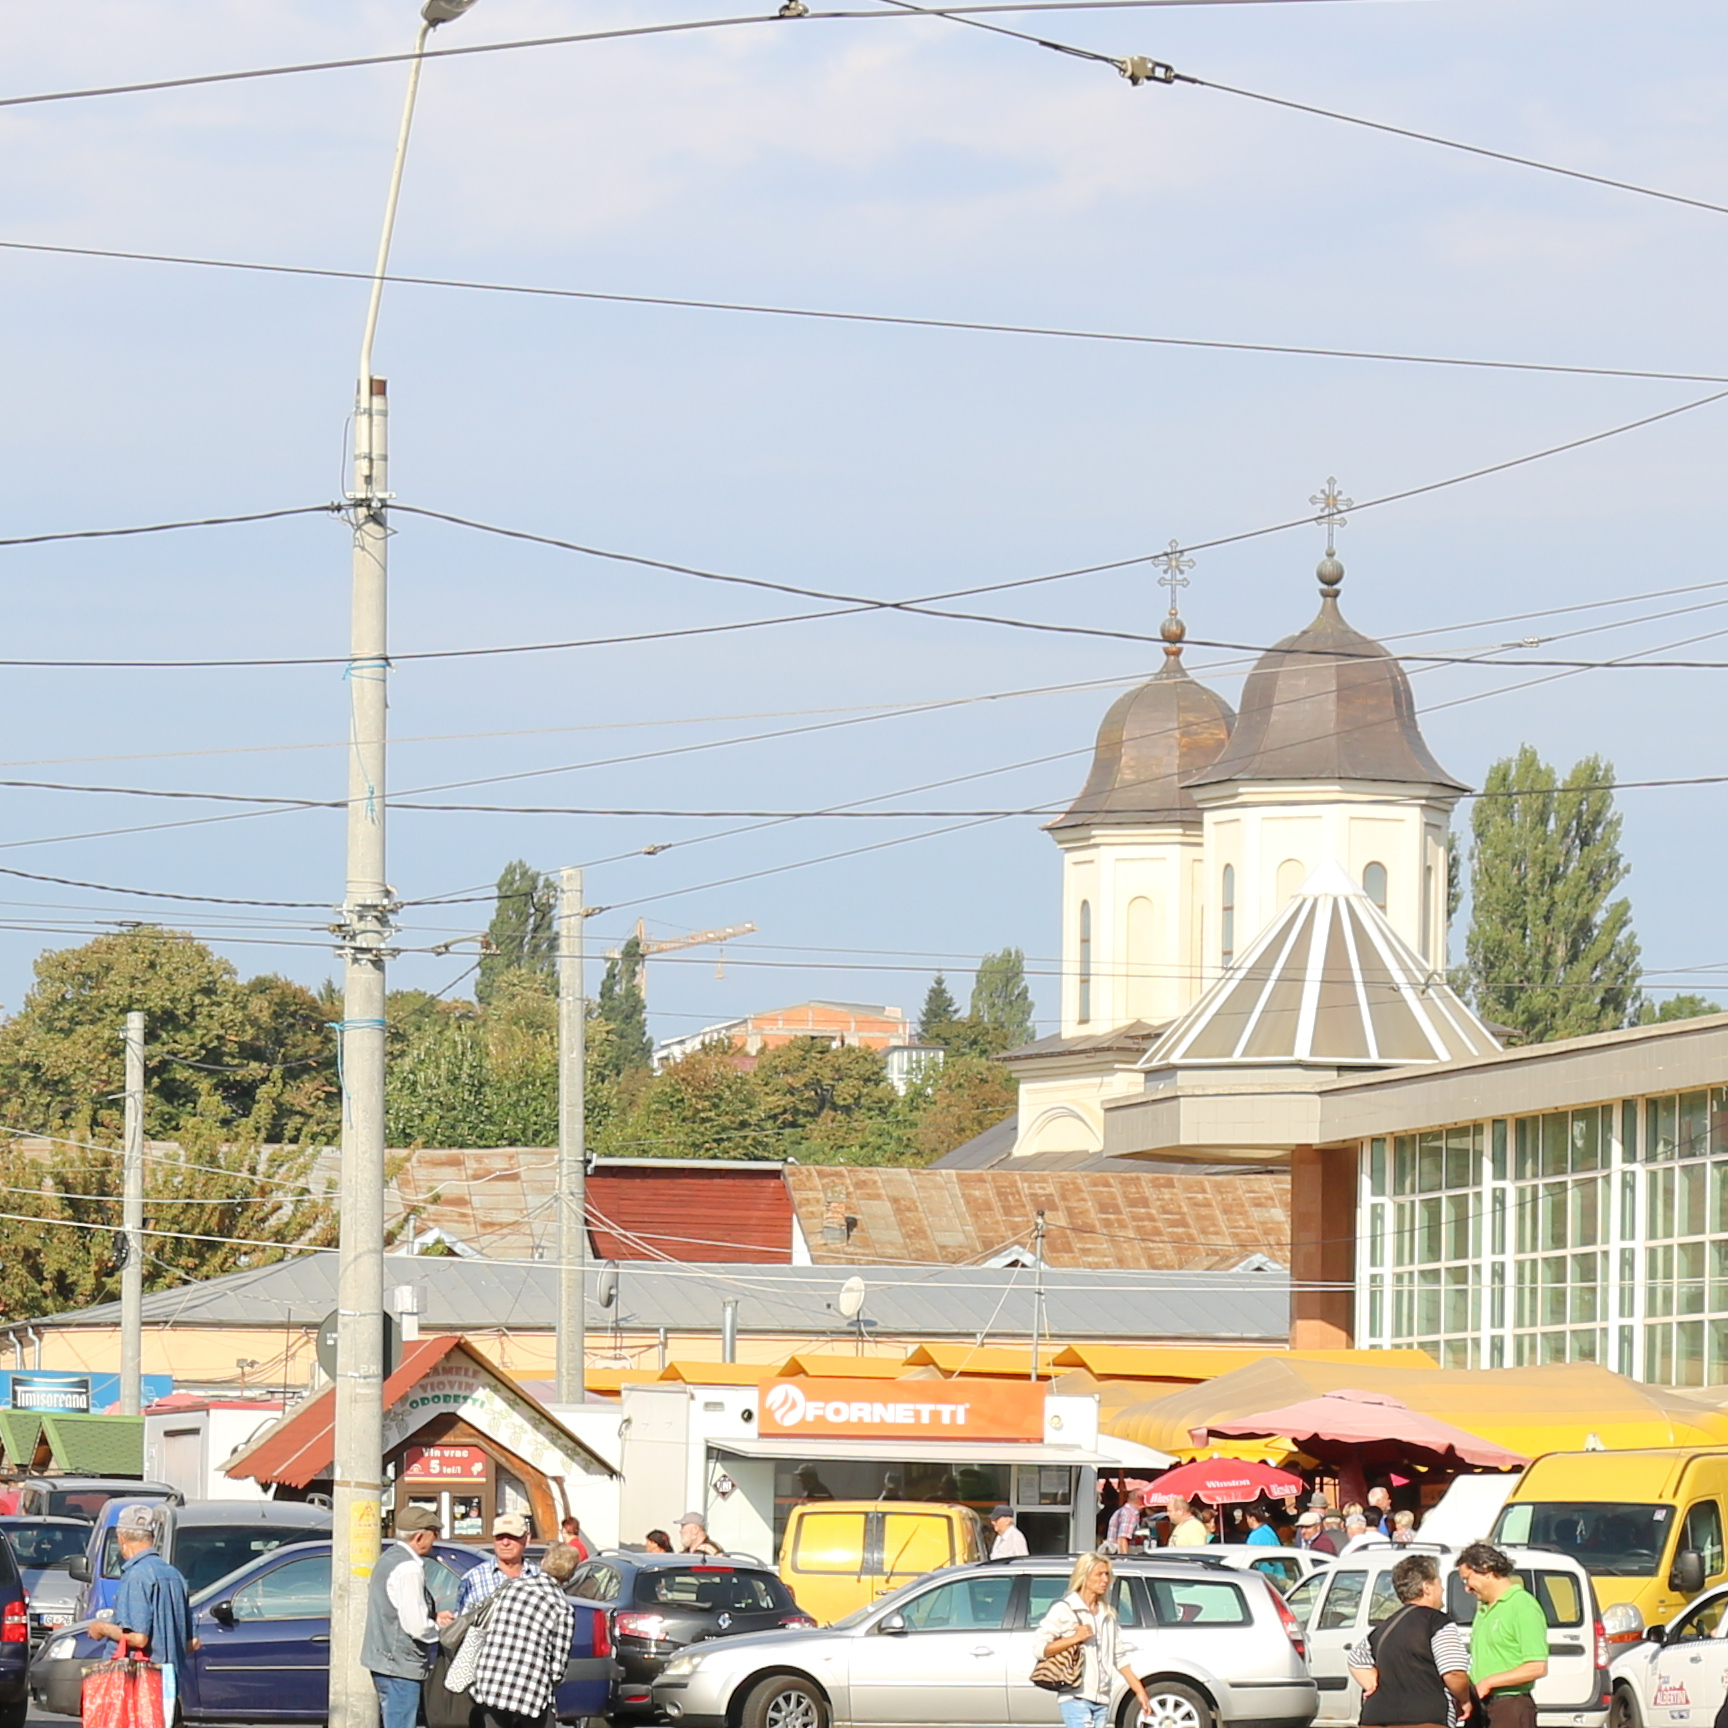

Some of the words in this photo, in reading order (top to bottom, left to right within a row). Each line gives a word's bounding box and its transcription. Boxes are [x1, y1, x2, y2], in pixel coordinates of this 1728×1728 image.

[427, 1366, 481, 1379] AMELE
[419, 1380, 474, 1393] VIOVIN
[15, 1386, 87, 1409] Timisoreana
[409, 1394, 485, 1410] ODOBESTI
[805, 1401, 967, 1425] FORNETTI
[422, 1448, 441, 1457] Vin
[443, 1449, 469, 1458] vrac
[429, 1460, 440, 1473] 5
[1205, 1479, 1251, 1489] Winston
